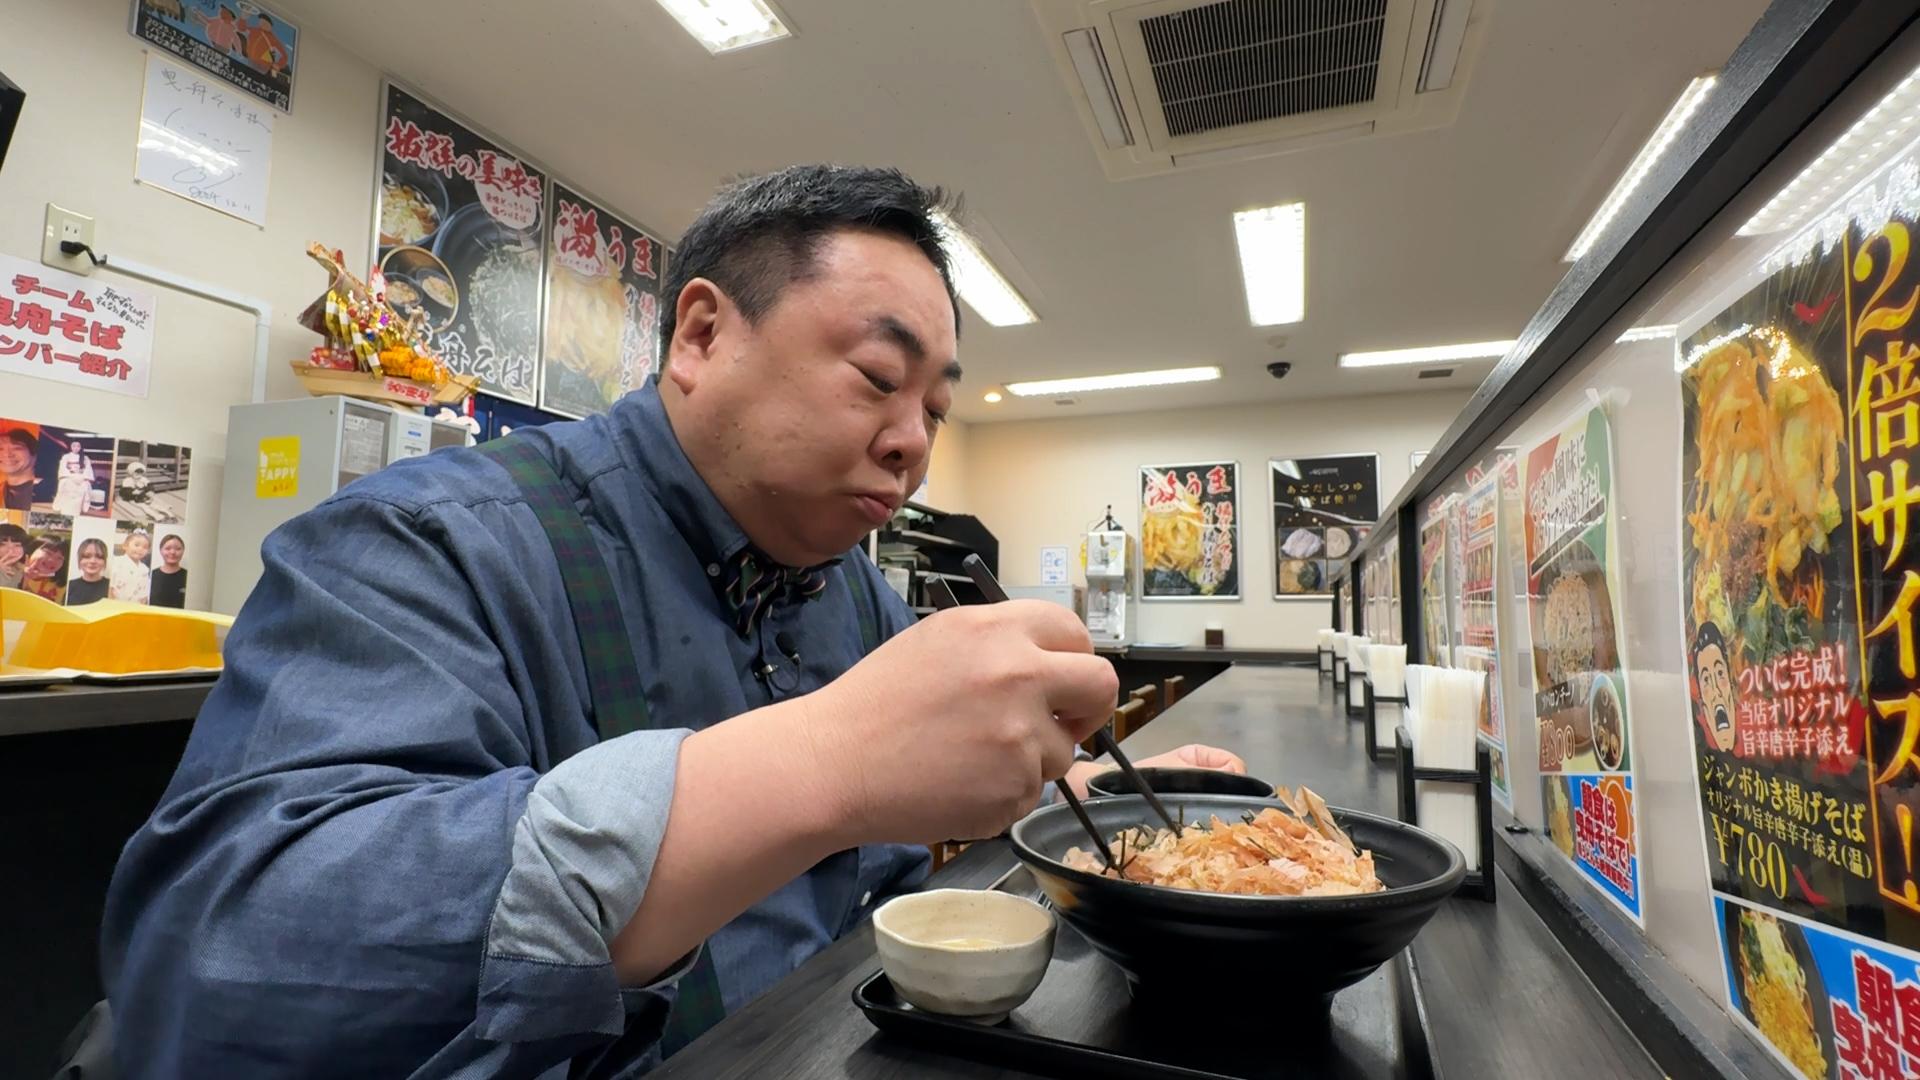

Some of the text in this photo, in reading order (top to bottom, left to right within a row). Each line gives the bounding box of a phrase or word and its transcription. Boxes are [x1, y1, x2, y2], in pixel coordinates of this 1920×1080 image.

[12, 273, 95, 313] チーム
[424, 322, 533, 396] 舟そば
[1738, 644, 1846, 694] ついに完成!
[1740, 692, 1849, 728] 当店オリジナル
[1742, 727, 1854, 758] 旨辛唐辛子添え
[1703, 754, 1867, 844] ジャンボかき揚げそば
[1709, 811, 1788, 900] ¥780
